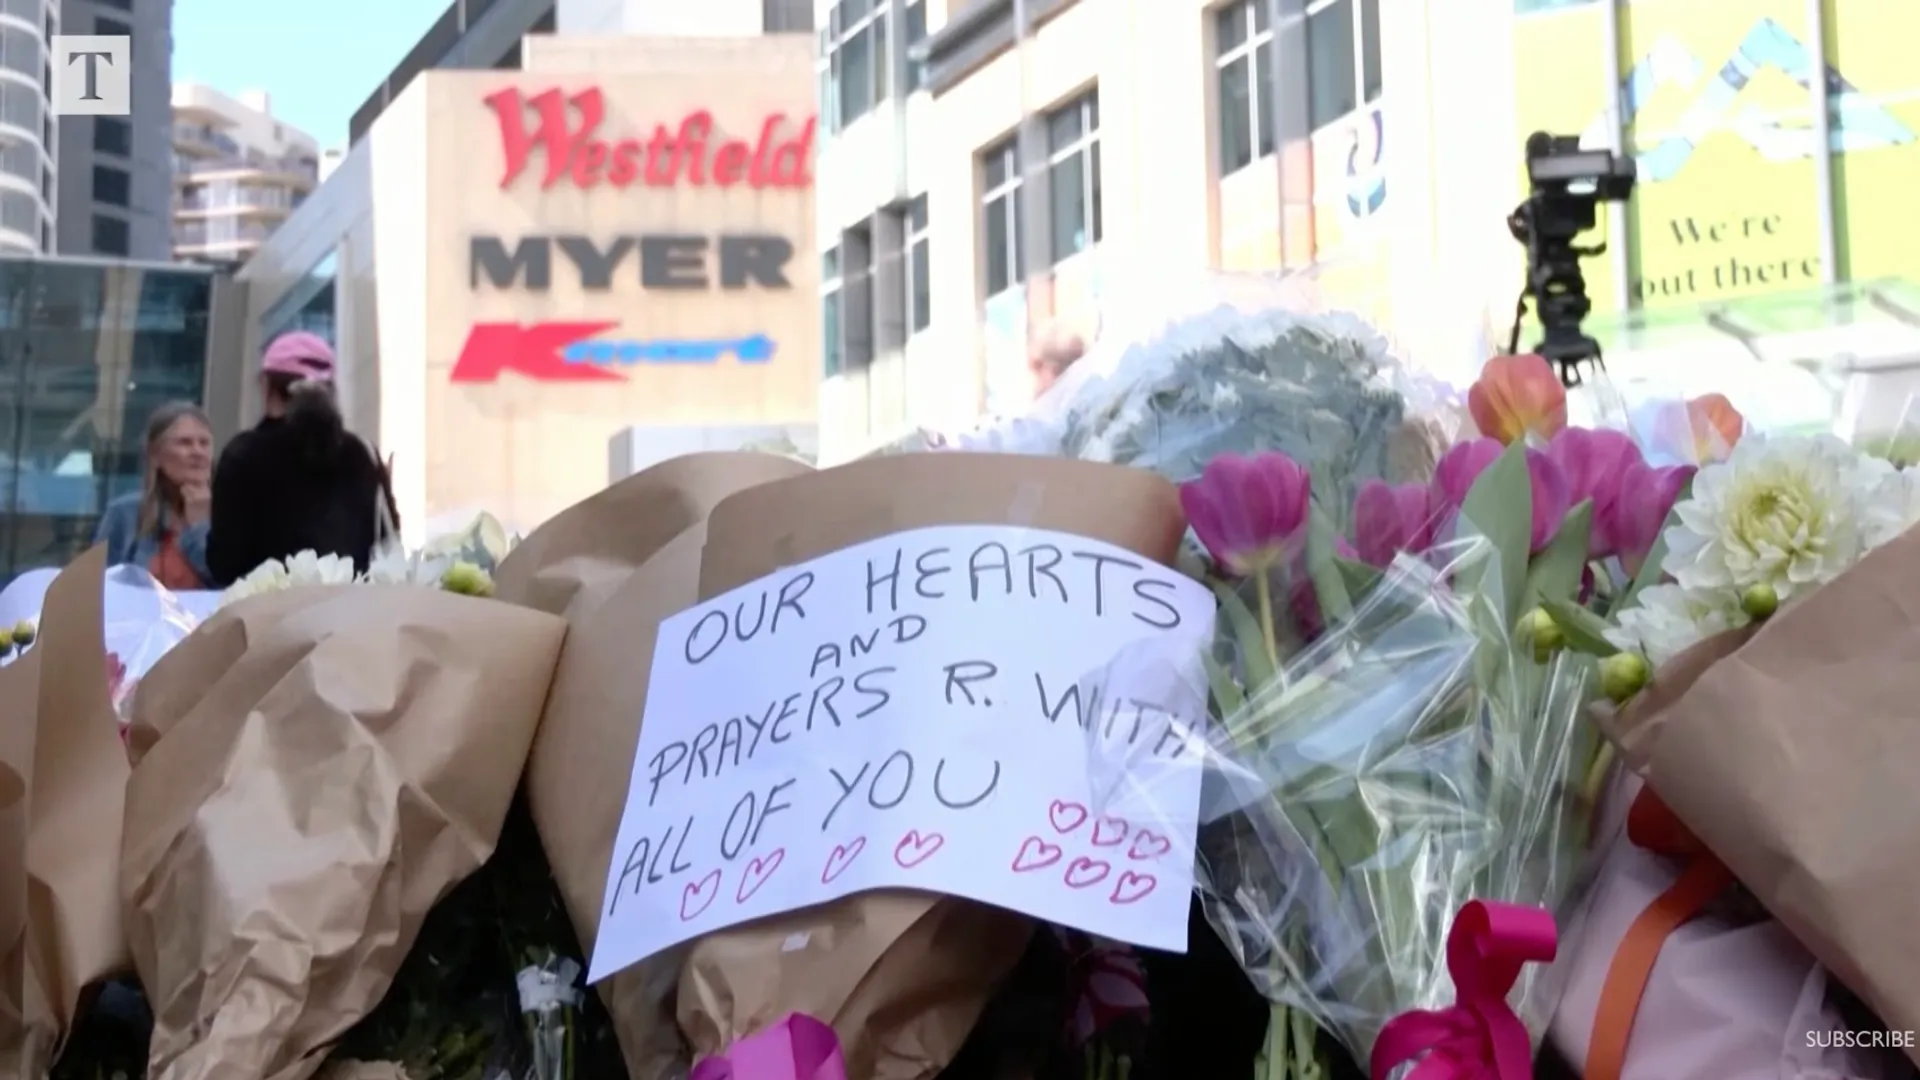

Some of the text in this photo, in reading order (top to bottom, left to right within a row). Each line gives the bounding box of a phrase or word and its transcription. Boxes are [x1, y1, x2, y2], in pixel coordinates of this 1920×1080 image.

[482, 86, 818, 192] Westfield
[470, 235, 794, 291] MYER
[1714, 256, 1821, 289] there
[685, 542, 1182, 664] OUR HEARTS
[810, 615, 927, 678] AND
[649, 661, 1199, 807] PRAYERS R. WITH
[609, 750, 1000, 917] ALL OF YOU
